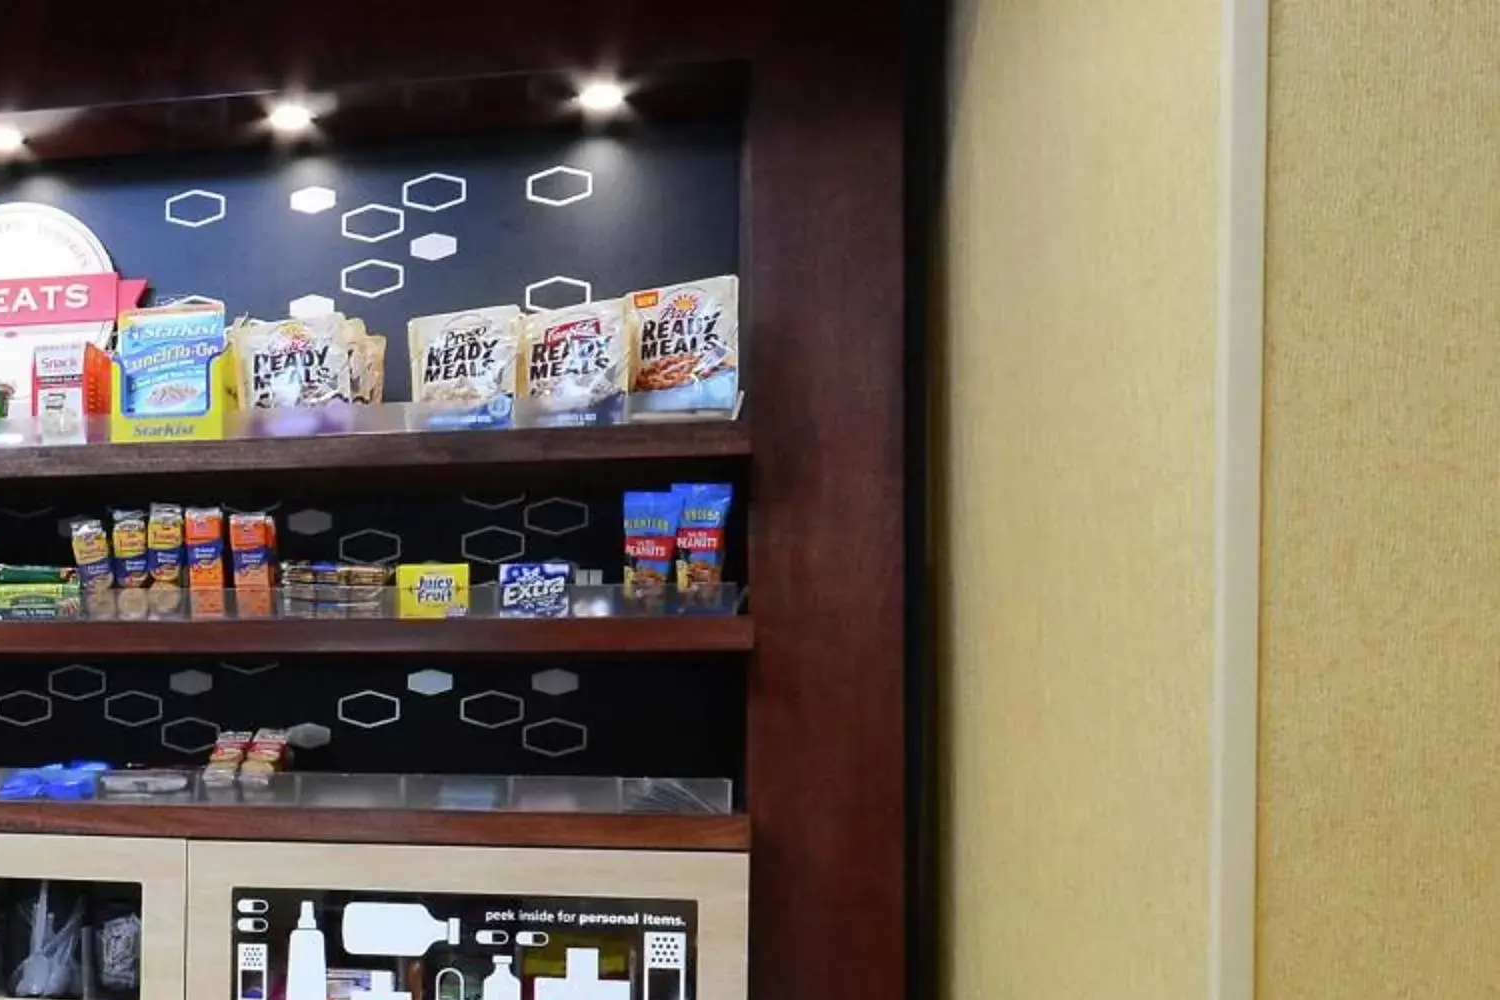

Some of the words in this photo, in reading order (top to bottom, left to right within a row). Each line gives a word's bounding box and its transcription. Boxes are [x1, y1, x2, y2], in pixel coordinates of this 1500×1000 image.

[642, 310, 722, 342] READY
[428, 339, 499, 367] READY
[417, 575, 454, 590] Juicy
[503, 577, 566, 605] Extra
[416, 590, 453, 604] Fruit
[485, 909, 516, 922] peek
[518, 910, 555, 923] inside
[557, 910, 577, 923] for
[579, 913, 639, 926] personal
